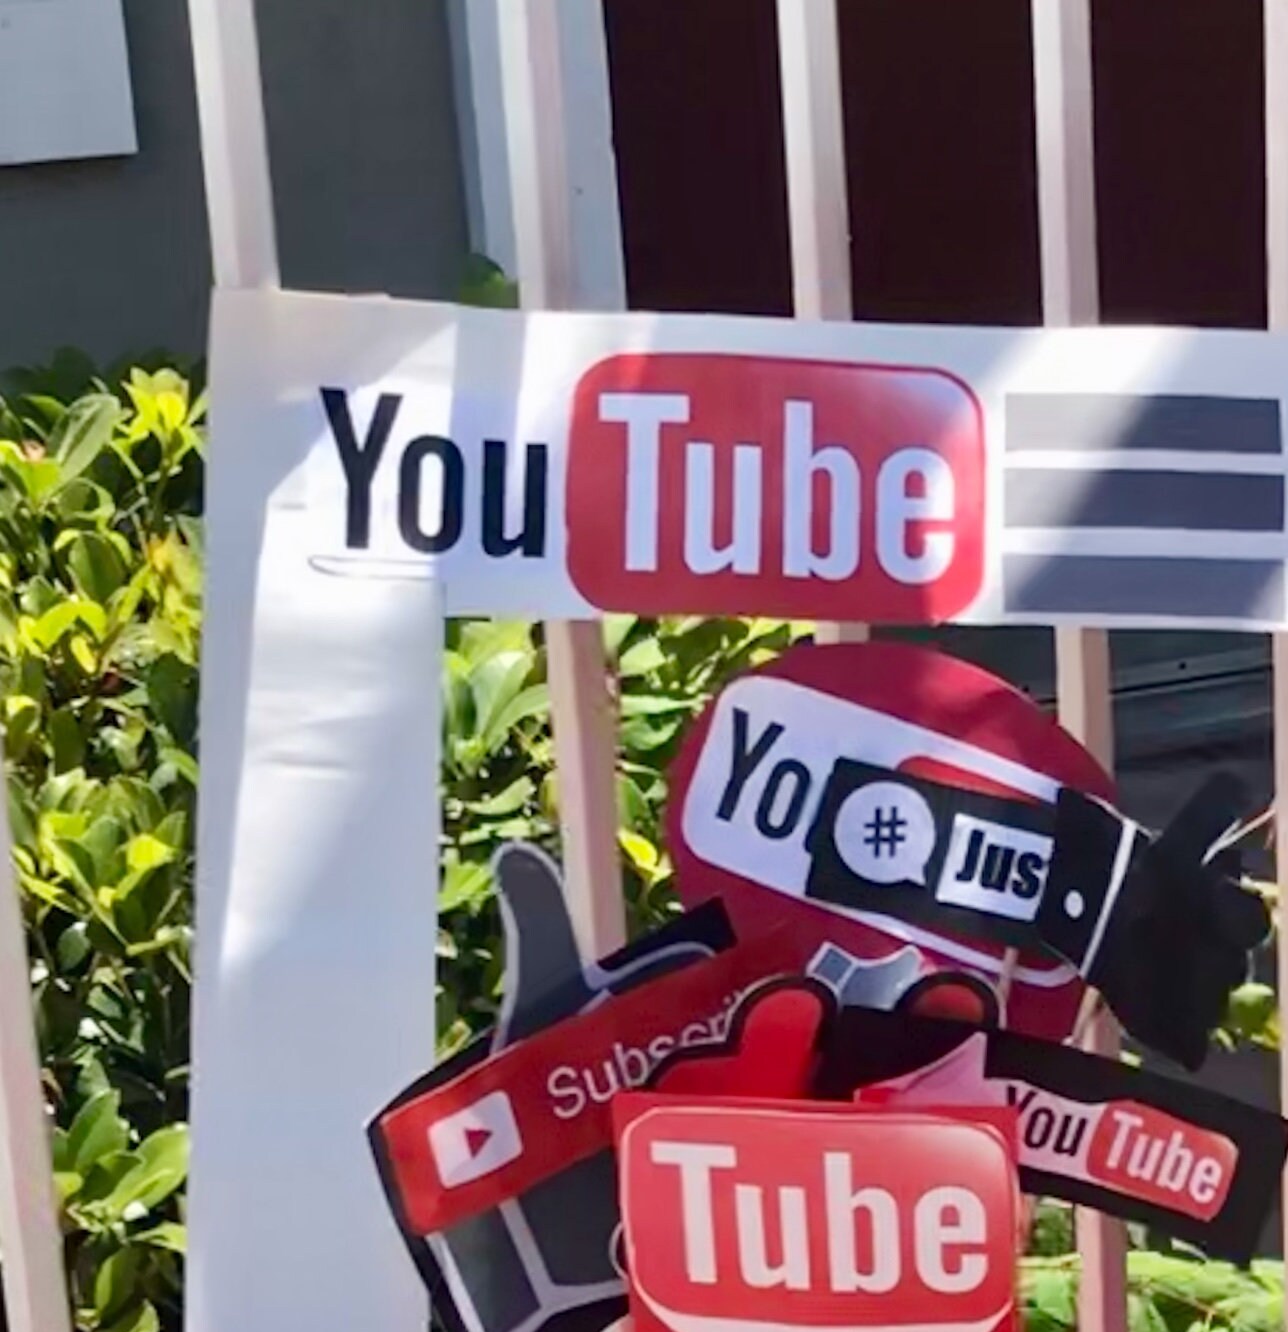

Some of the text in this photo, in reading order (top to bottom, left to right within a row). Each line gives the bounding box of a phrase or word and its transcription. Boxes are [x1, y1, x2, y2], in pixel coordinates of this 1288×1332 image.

[318, 386, 957, 585] YouTube
[715, 707, 811, 840] Yo
[863, 806, 1050, 899] # Jus
[650, 1140, 989, 1295] Tube
